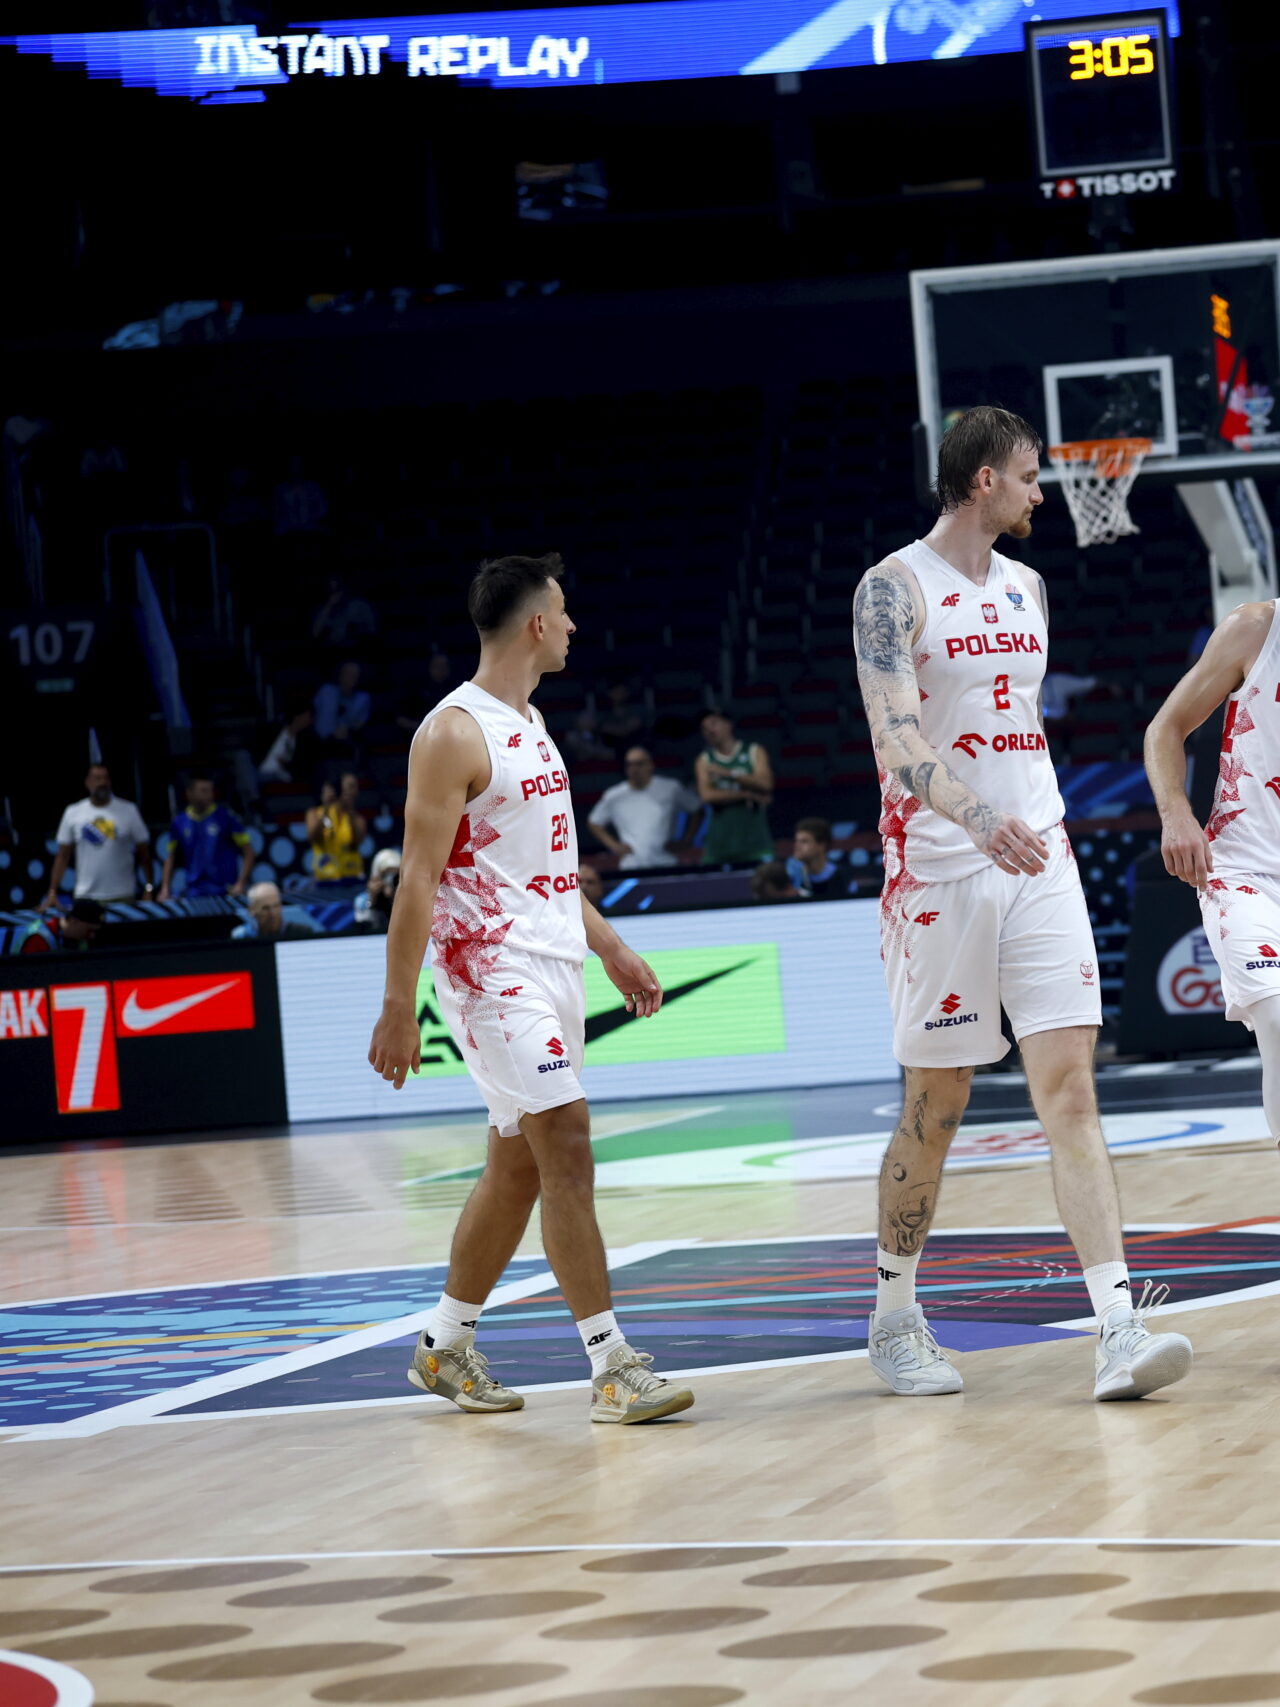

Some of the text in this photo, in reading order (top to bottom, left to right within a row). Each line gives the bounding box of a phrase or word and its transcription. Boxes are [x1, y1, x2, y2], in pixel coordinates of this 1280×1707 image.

[195, 34, 590, 78] INSTANT REPLAY
[1068, 34, 1154, 80] 3:05
[1076, 169, 1176, 198] TISSOT
[941, 593, 960, 607] 4F
[9, 621, 95, 666] 107
[945, 632, 1042, 659] POLSKA
[993, 674, 1011, 710] 2
[507, 733, 522, 748] 4F
[992, 733, 1046, 752] ORLEN
[520, 770, 570, 801] POLSK
[551, 813, 568, 852] 28
[914, 911, 940, 926] 4F
[925, 1013, 978, 1031] SUZUKI
[53, 985, 108, 1111] 7
[537, 1059, 570, 1073] SUZU
[587, 1329, 613, 1346] 4F
